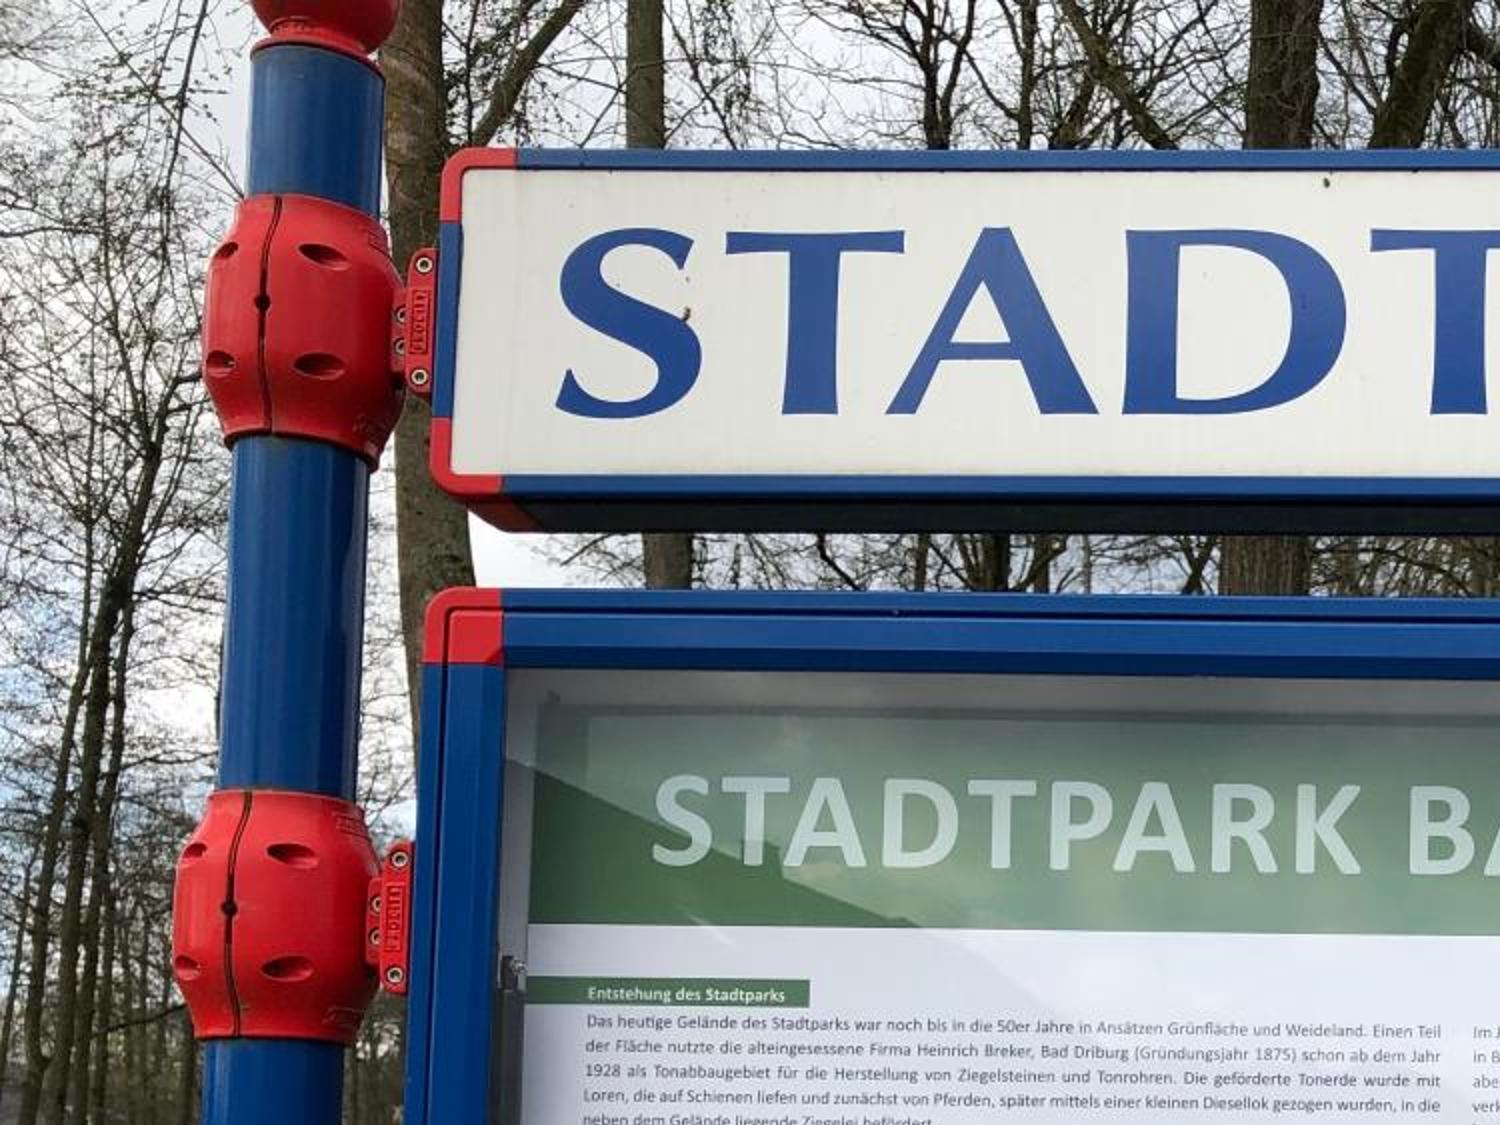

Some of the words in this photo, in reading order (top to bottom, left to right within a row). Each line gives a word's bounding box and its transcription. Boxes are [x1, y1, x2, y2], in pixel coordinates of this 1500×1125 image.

[652, 775, 1362, 875] STADTPARK
[588, 986, 670, 1003] Entstehung
[675, 988, 700, 1001] des
[705, 988, 785, 1004] Stadtparks
[587, 1014, 613, 1027] Das
[617, 1014, 672, 1030] heutige
[676, 1015, 738, 1028] Gelände
[741, 1016, 767, 1029] des
[771, 1016, 850, 1032] Stadtparks
[854, 1021, 882, 1030] war
[886, 1018, 923, 1031] noch
[927, 1018, 947, 1031] bis
[952, 1019, 965, 1031] in
[969, 1019, 992, 1032] die
[997, 1020, 1030, 1032] 50er
[1034, 1020, 1074, 1033] Jahre
[1078, 1020, 1092, 1033] in
[1096, 1021, 1162, 1034] Ansätzen
[1167, 1022, 1248, 1035] Grünfläche
[1253, 1023, 1280, 1035] und
[1285, 1023, 1368, 1036] Weideland.
[1372, 1024, 1412, 1037] Einen
[1416, 1025, 1441, 1038] Teil
[582, 1113, 628, 1125] neben
[632, 1114, 665, 1125] dem
